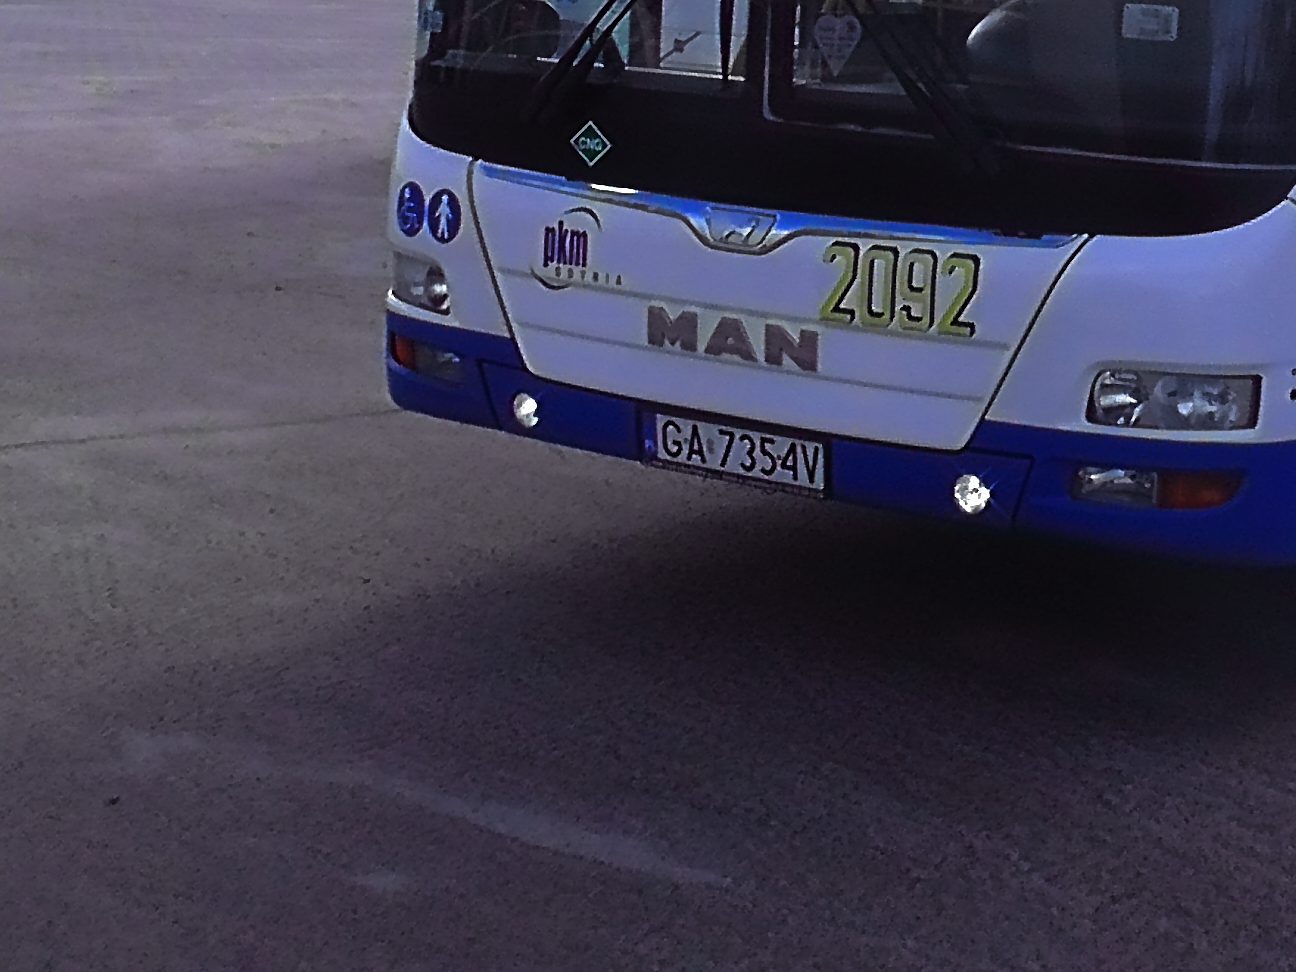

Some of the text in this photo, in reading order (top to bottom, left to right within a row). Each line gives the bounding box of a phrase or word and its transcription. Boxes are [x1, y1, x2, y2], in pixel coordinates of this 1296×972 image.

[578, 136, 602, 151] CNG
[543, 220, 588, 268] pkm
[819, 240, 981, 337] 2092
[647, 304, 819, 373] MAN
[661, 419, 820, 484] GA 7354V
